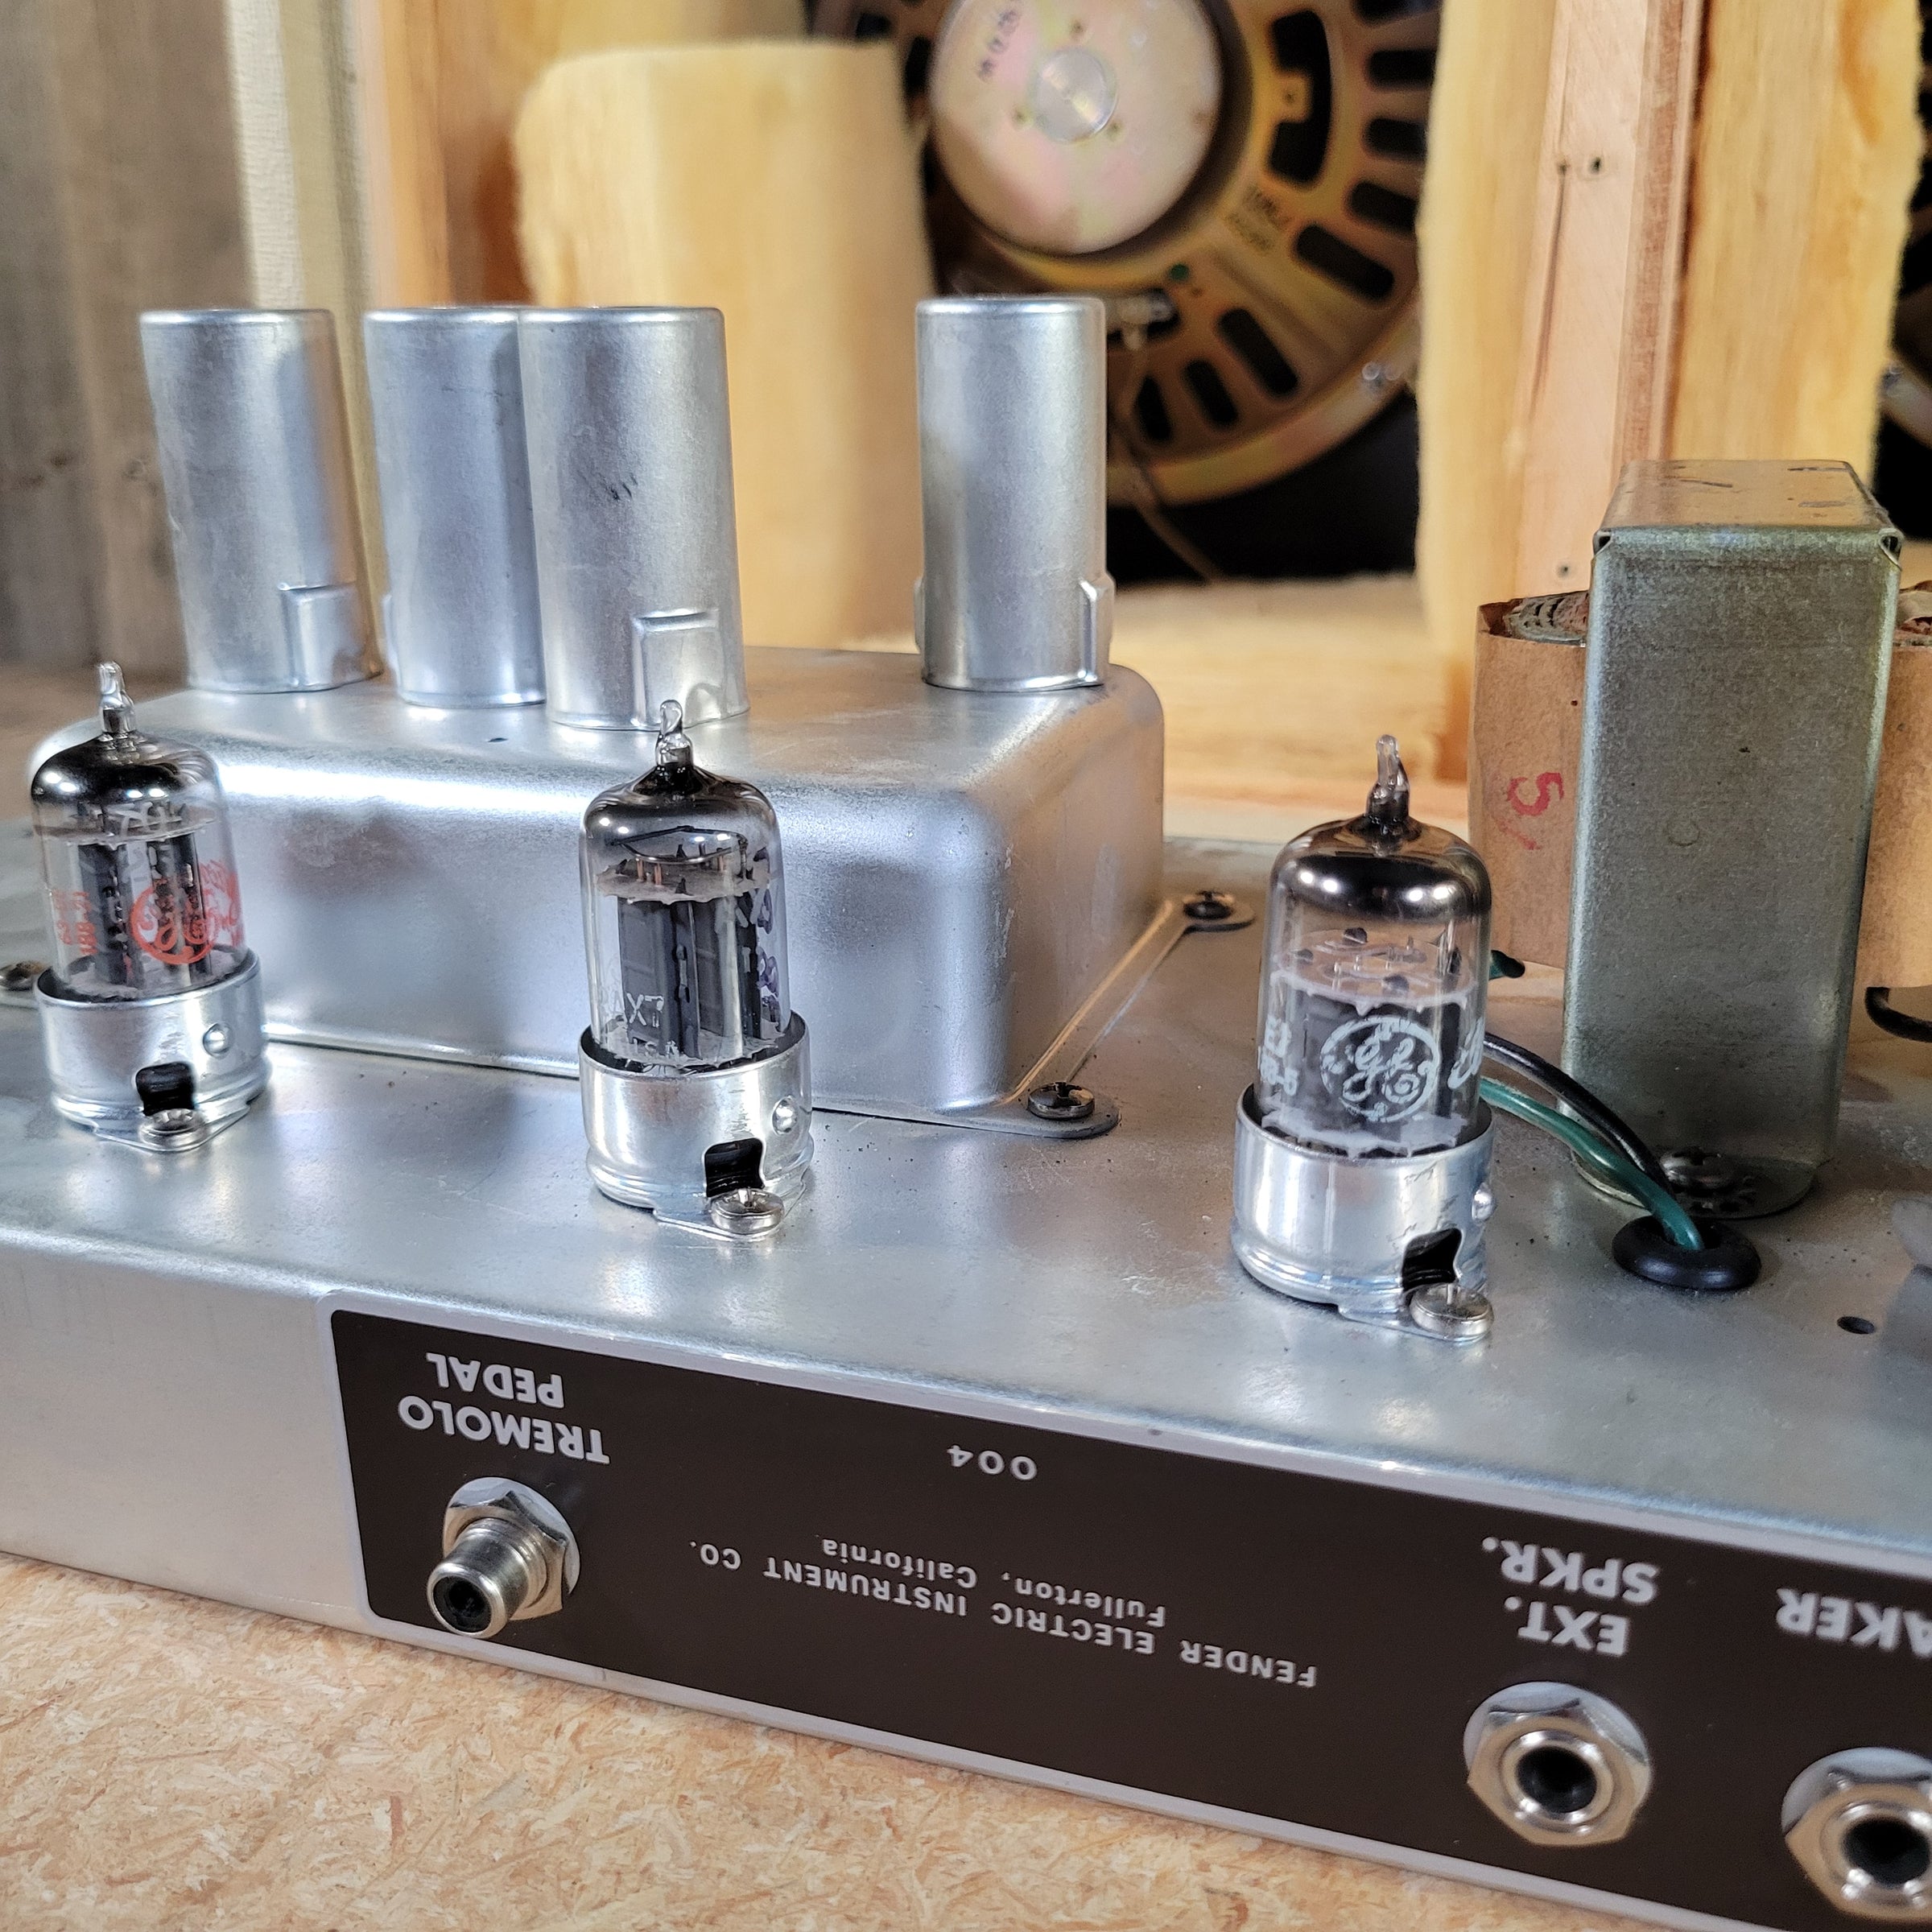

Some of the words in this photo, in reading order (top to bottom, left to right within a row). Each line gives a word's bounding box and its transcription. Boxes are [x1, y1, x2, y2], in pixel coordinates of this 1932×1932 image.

[426, 1352, 565, 1409] PEDAL
[398, 1395, 610, 1464] TREMOLO
[689, 1539, 741, 1571] CO.
[821, 1538, 977, 1588] California
[1482, 1536, 1659, 1604] SPKR.
[762, 1556, 967, 1616] INSTRUMENT
[1001, 1571, 1166, 1628] Fullerton,
[991, 1602, 1155, 1654] ELECTRIC
[1505, 1596, 1630, 1657] EXT.
[1179, 1639, 1317, 1688] FENDER
